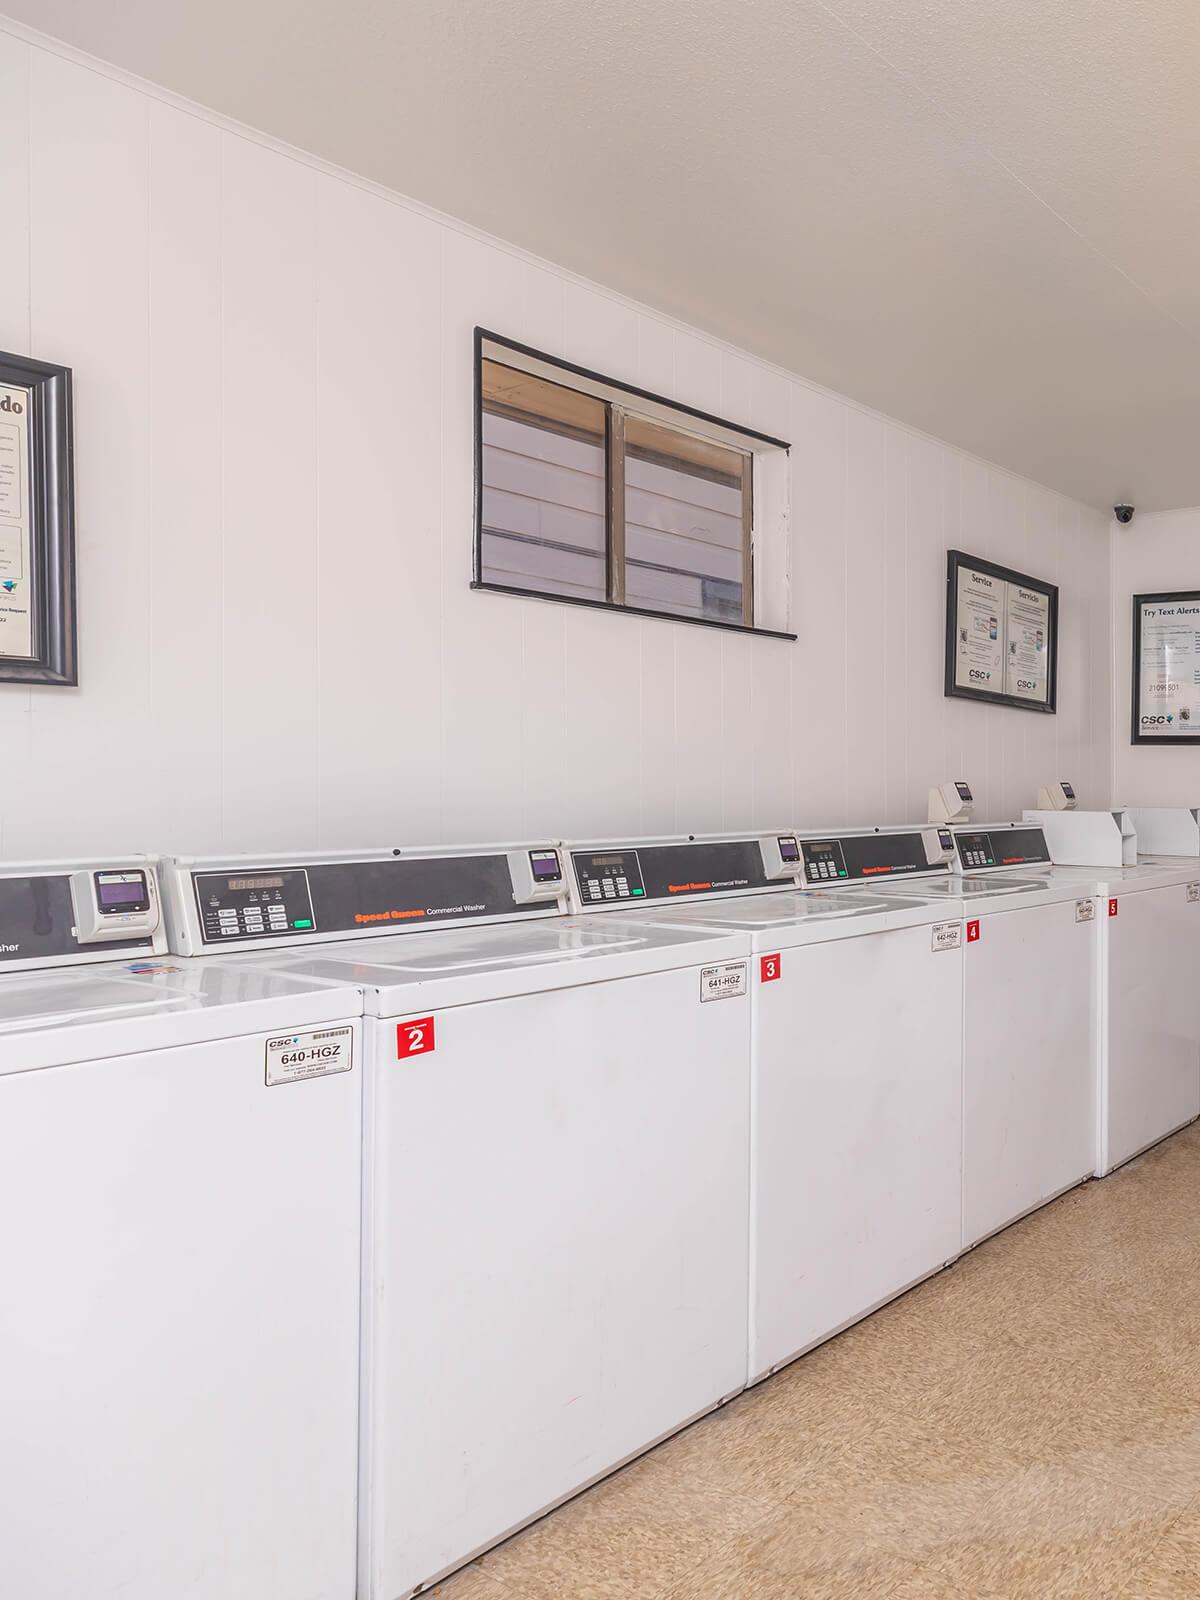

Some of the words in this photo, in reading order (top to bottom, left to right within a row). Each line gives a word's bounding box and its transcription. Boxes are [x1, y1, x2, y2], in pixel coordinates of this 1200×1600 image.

[0, 394, 23, 415] do
[1144, 609, 1157, 618] Try
[1158, 608, 1175, 616] Text
[968, 669, 986, 680] CSC
[1016, 679, 1032, 689] CSC
[1141, 715, 1166, 724] CSC
[426, 905, 463, 916] Commercial
[463, 903, 486, 912] Washer
[1111, 903, 1116, 914] 5
[970, 926, 976, 939] 4
[766, 961, 776, 977] 3
[708, 975, 742, 989] 641-HGZ
[269, 1038, 293, 1048] CSC
[408, 1029, 425, 1052] 2
[281, 1045, 341, 1065] 640-HGZ
